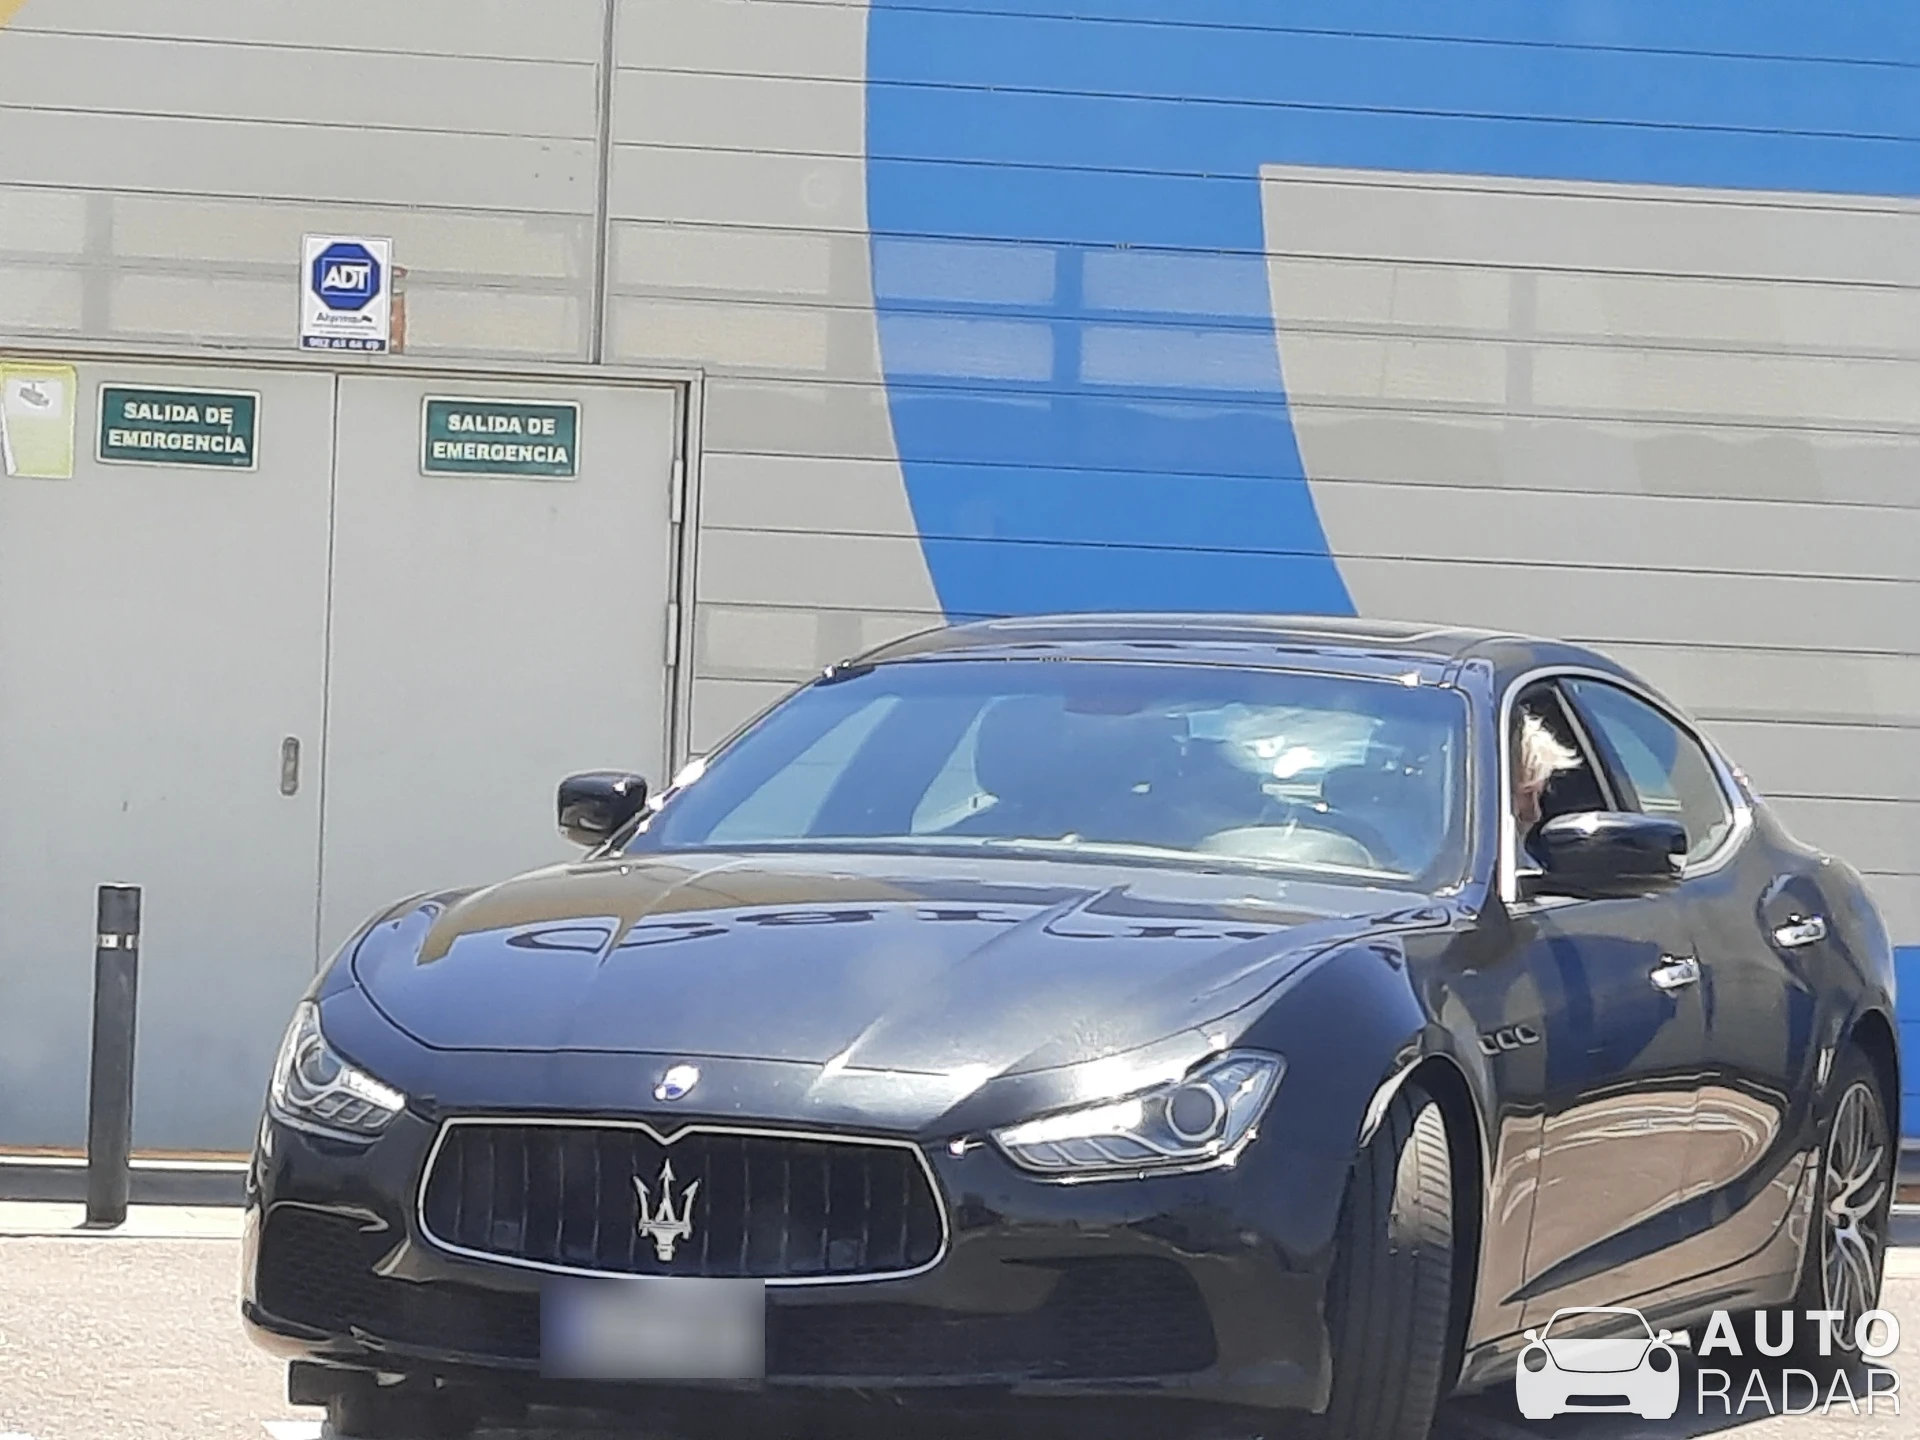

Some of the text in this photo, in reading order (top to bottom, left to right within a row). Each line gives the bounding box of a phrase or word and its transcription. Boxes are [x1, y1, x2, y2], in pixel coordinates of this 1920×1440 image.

[322, 265, 371, 290] ADT
[123, 402, 234, 424] SALIDA DE
[447, 414, 556, 435] SALIDA DE
[433, 441, 568, 463] EMERGENCIA
